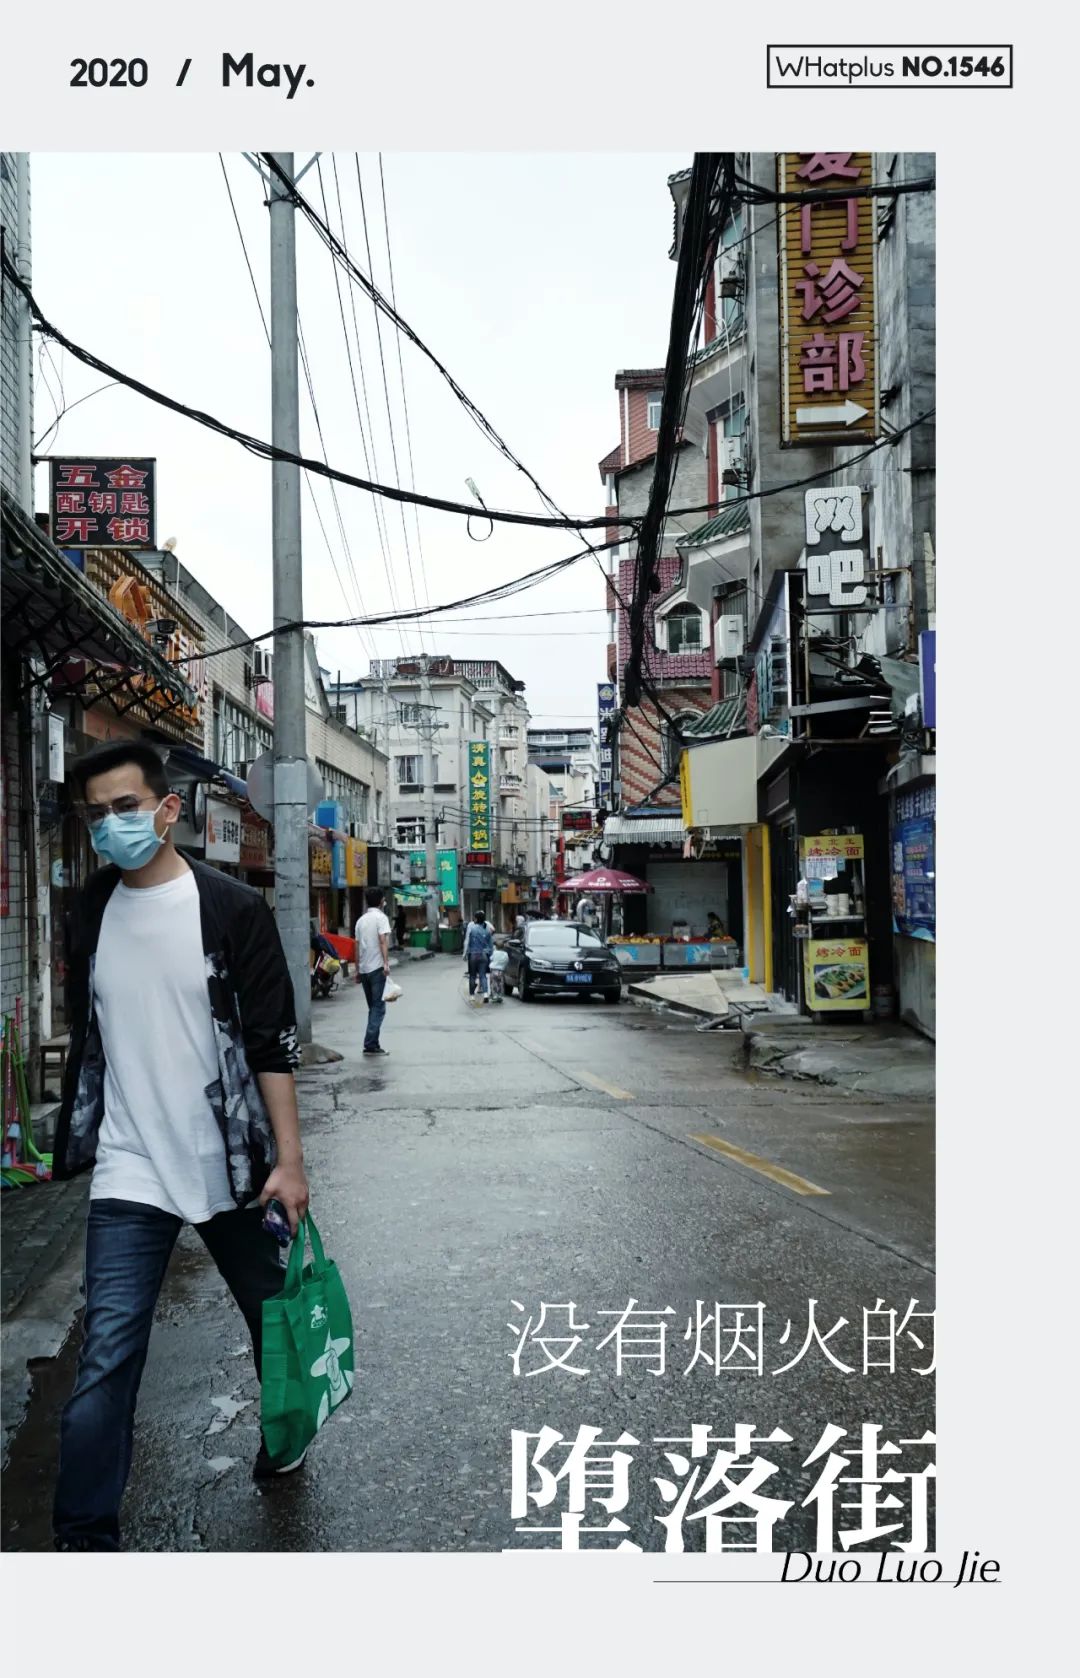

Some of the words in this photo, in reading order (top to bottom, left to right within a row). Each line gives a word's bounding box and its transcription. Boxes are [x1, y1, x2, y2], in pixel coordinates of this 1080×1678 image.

[57, 464, 149, 489] 五金
[57, 491, 150, 514] 配钥匙
[57, 516, 150, 542] 开锁
[804, 485, 868, 608] 网吧
